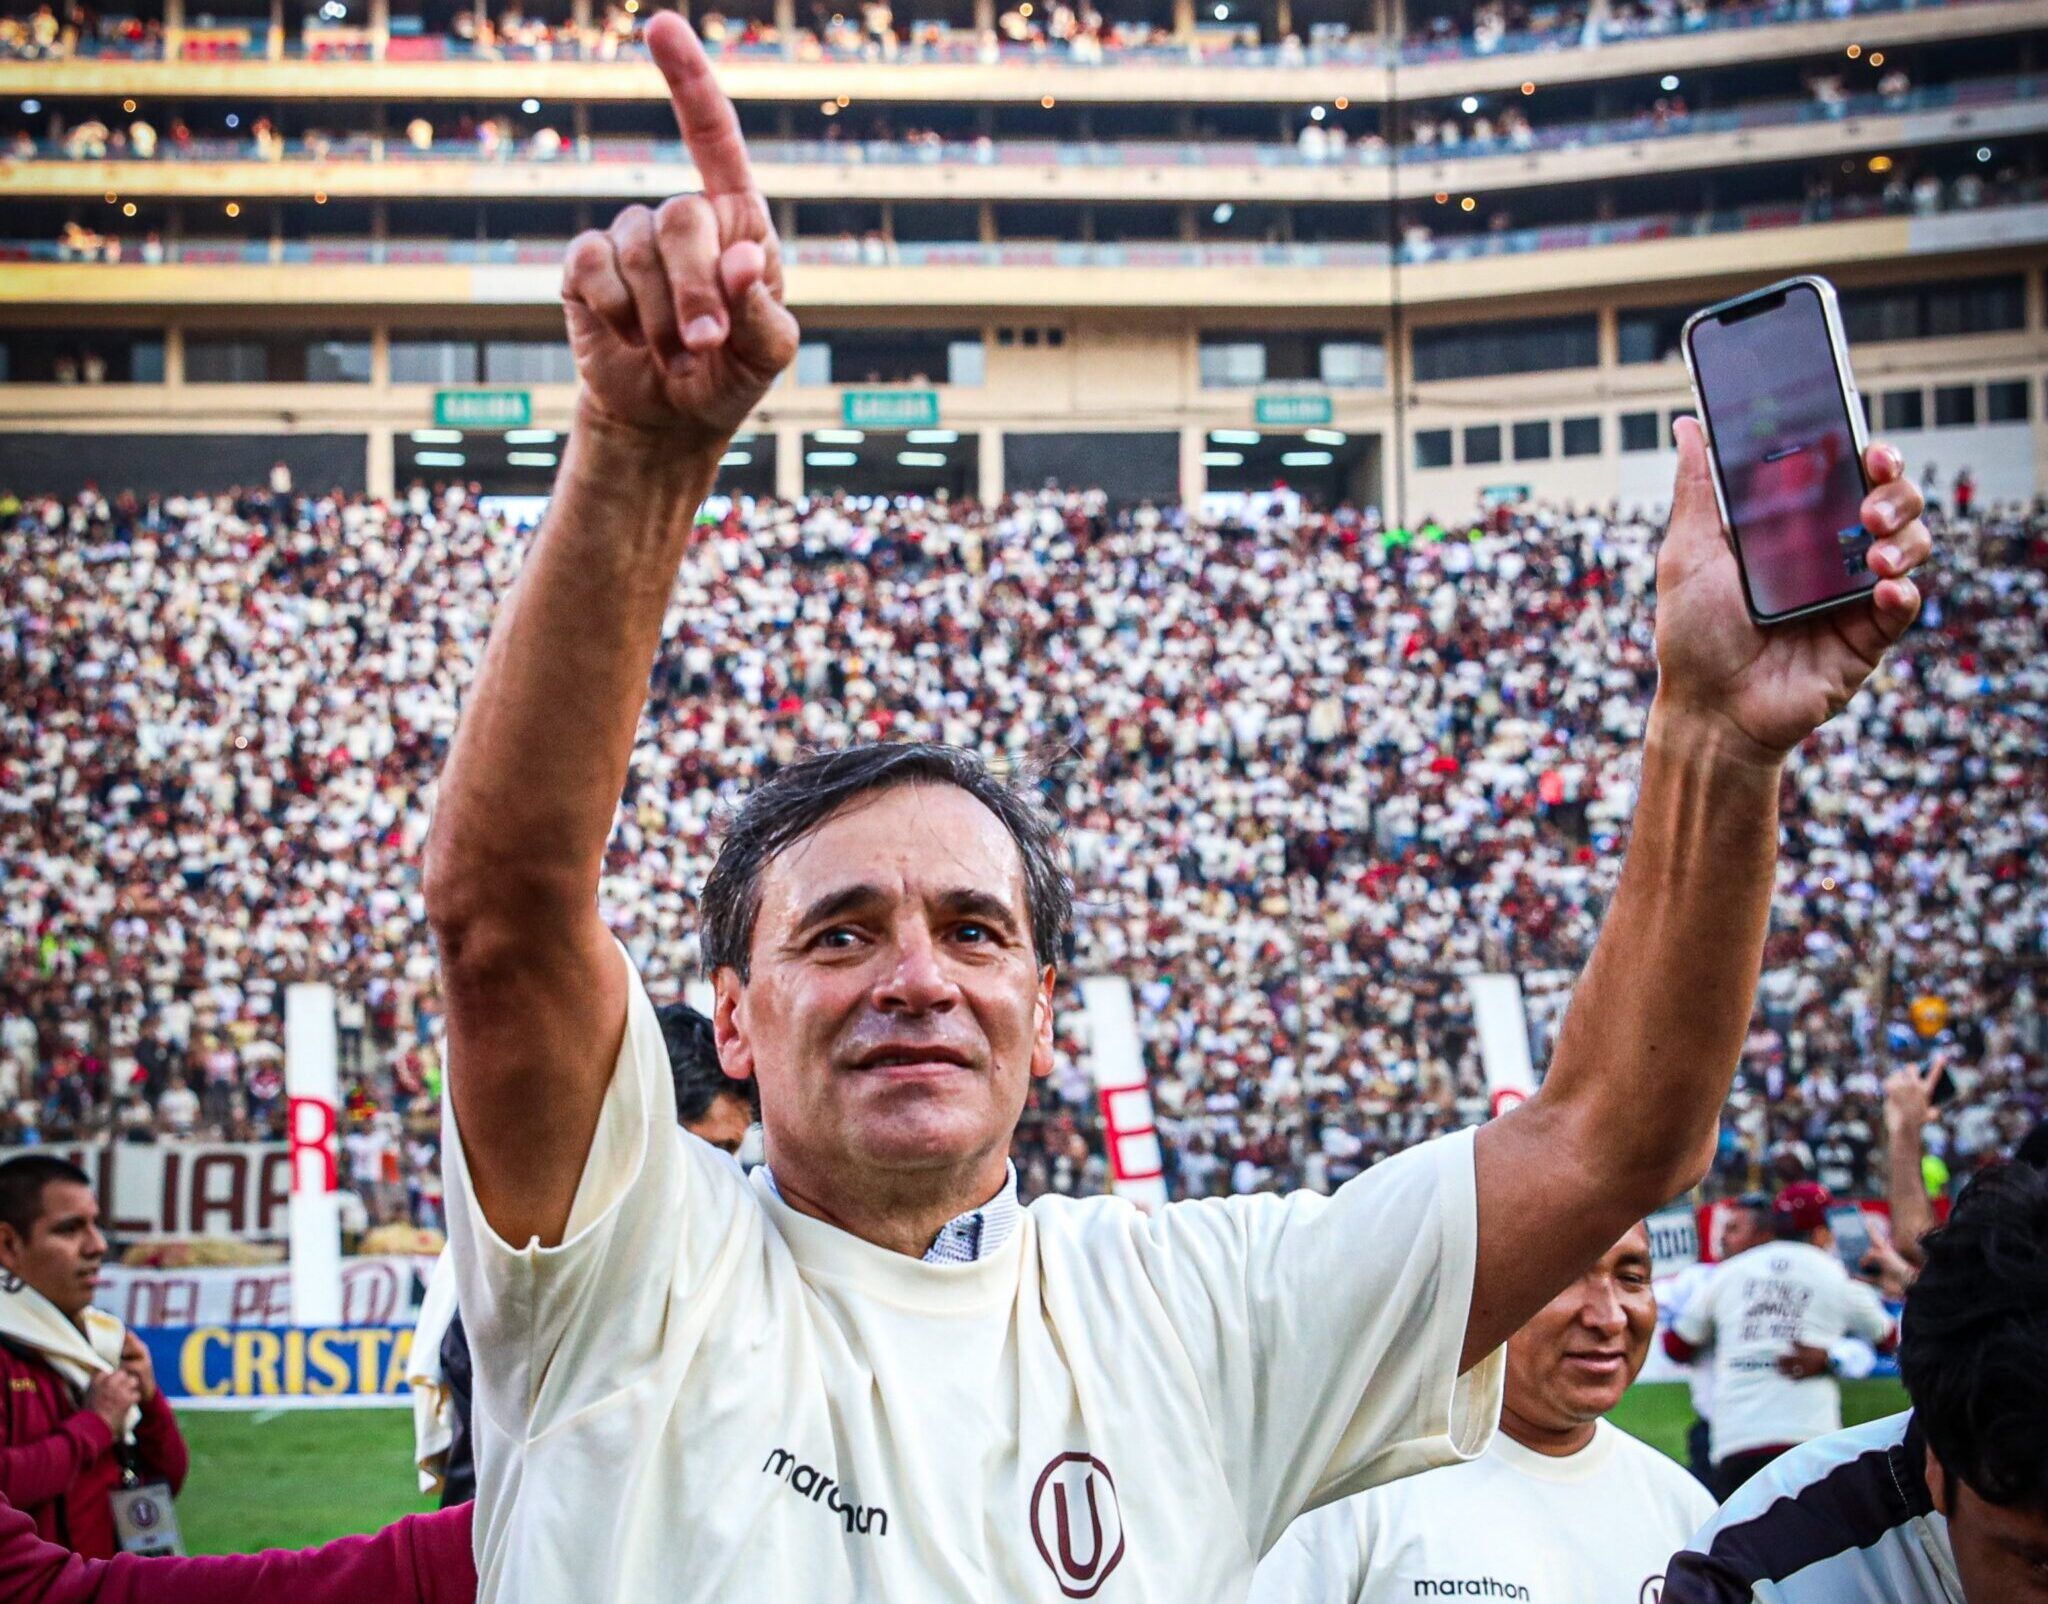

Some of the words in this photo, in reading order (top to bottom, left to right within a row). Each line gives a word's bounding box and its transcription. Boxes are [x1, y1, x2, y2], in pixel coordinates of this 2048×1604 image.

[288, 1097, 339, 1192] R
[1101, 1082, 1163, 1181] E
[68, 1150, 292, 1233] LIAR
[1414, 1576, 1531, 1602] marathon
